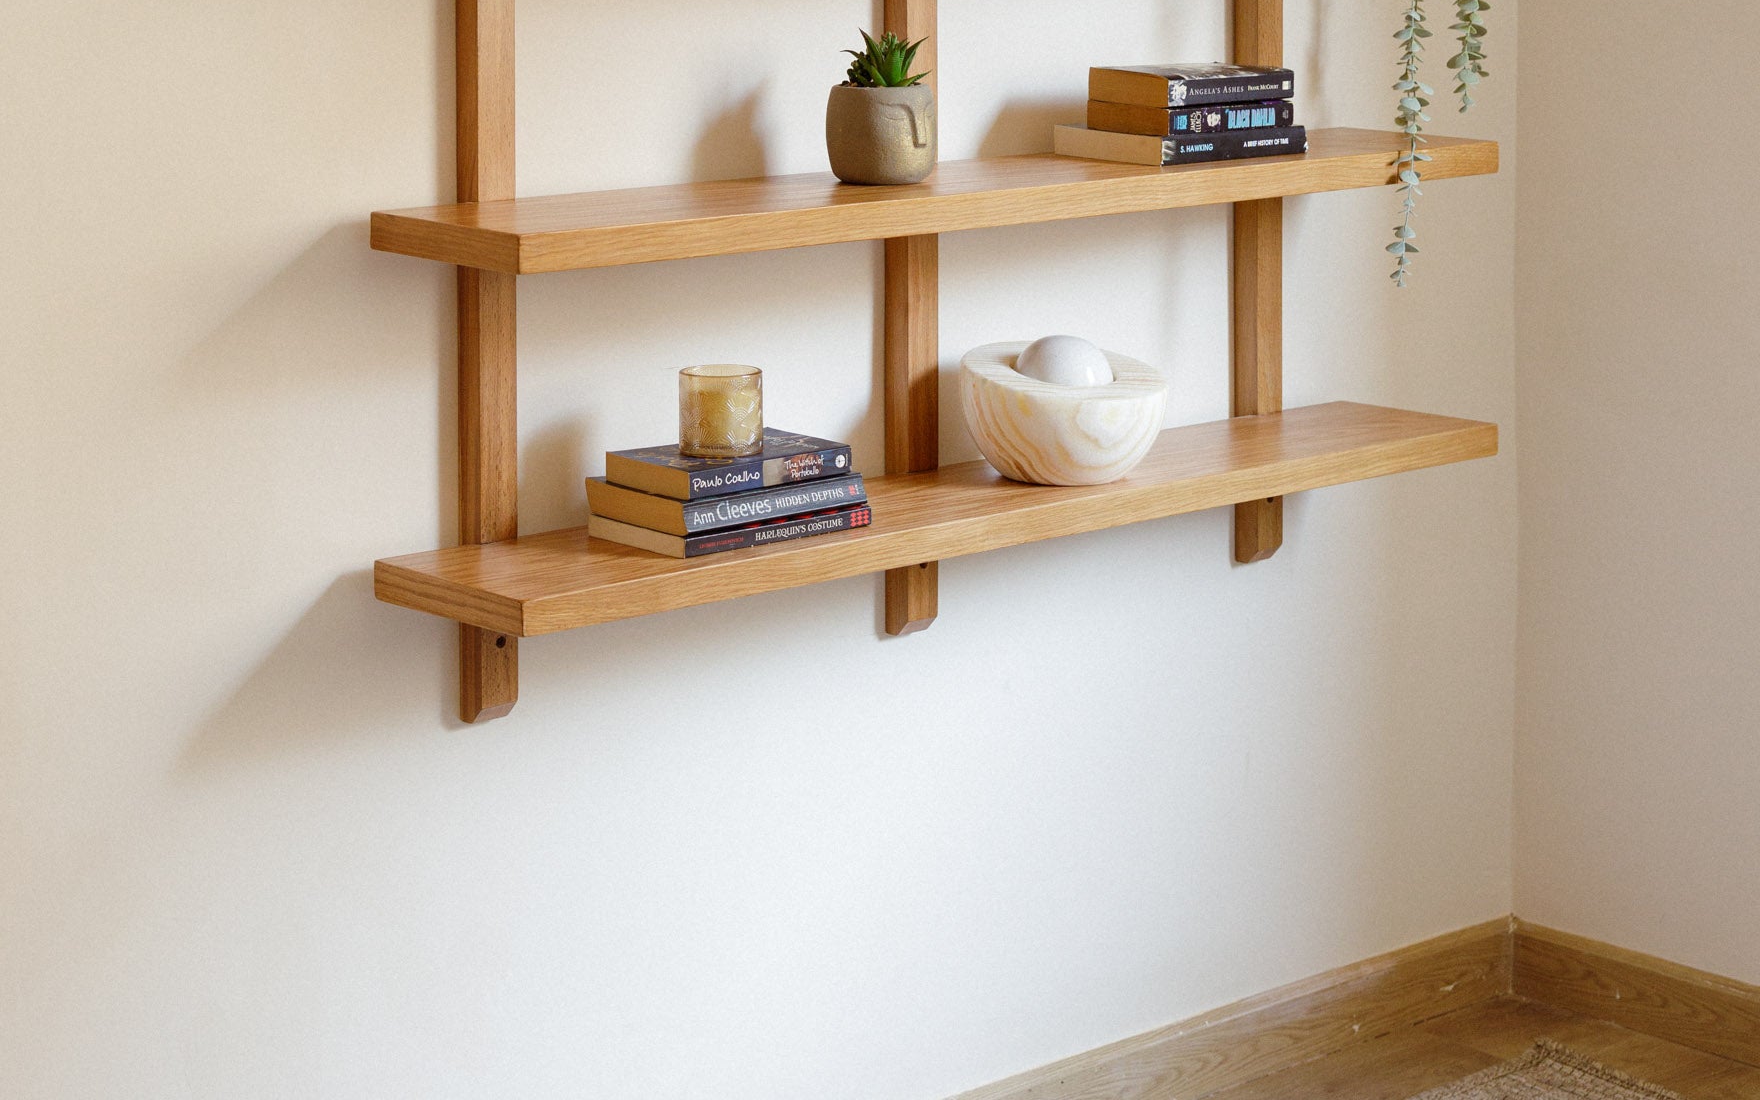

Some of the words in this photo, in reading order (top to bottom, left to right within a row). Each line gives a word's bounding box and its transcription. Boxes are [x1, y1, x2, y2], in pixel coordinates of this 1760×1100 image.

[1189, 87, 1220, 96] ANGELA'S
[1222, 85, 1244, 94] ASHES
[1186, 143, 1214, 153] HAWKING
[1247, 140, 1258, 148] BRIEF
[1257, 138, 1275, 147] HISTORY
[1274, 138, 1281, 146] OF
[1279, 137, 1289, 145] TIME
[784, 460, 797, 470] The
[816, 454, 825, 466] of
[790, 466, 820, 479] Portobello
[692, 475, 723, 492] Paulo
[725, 470, 760, 485] Coelho
[693, 511, 716, 525] Ann
[716, 499, 772, 521] Cleeves
[775, 493, 810, 509] HIDDEN
[811, 487, 845, 502] DEPTHS
[755, 522, 806, 541] HARLEQUIN'S
[807, 517, 843, 532] COSTUME
